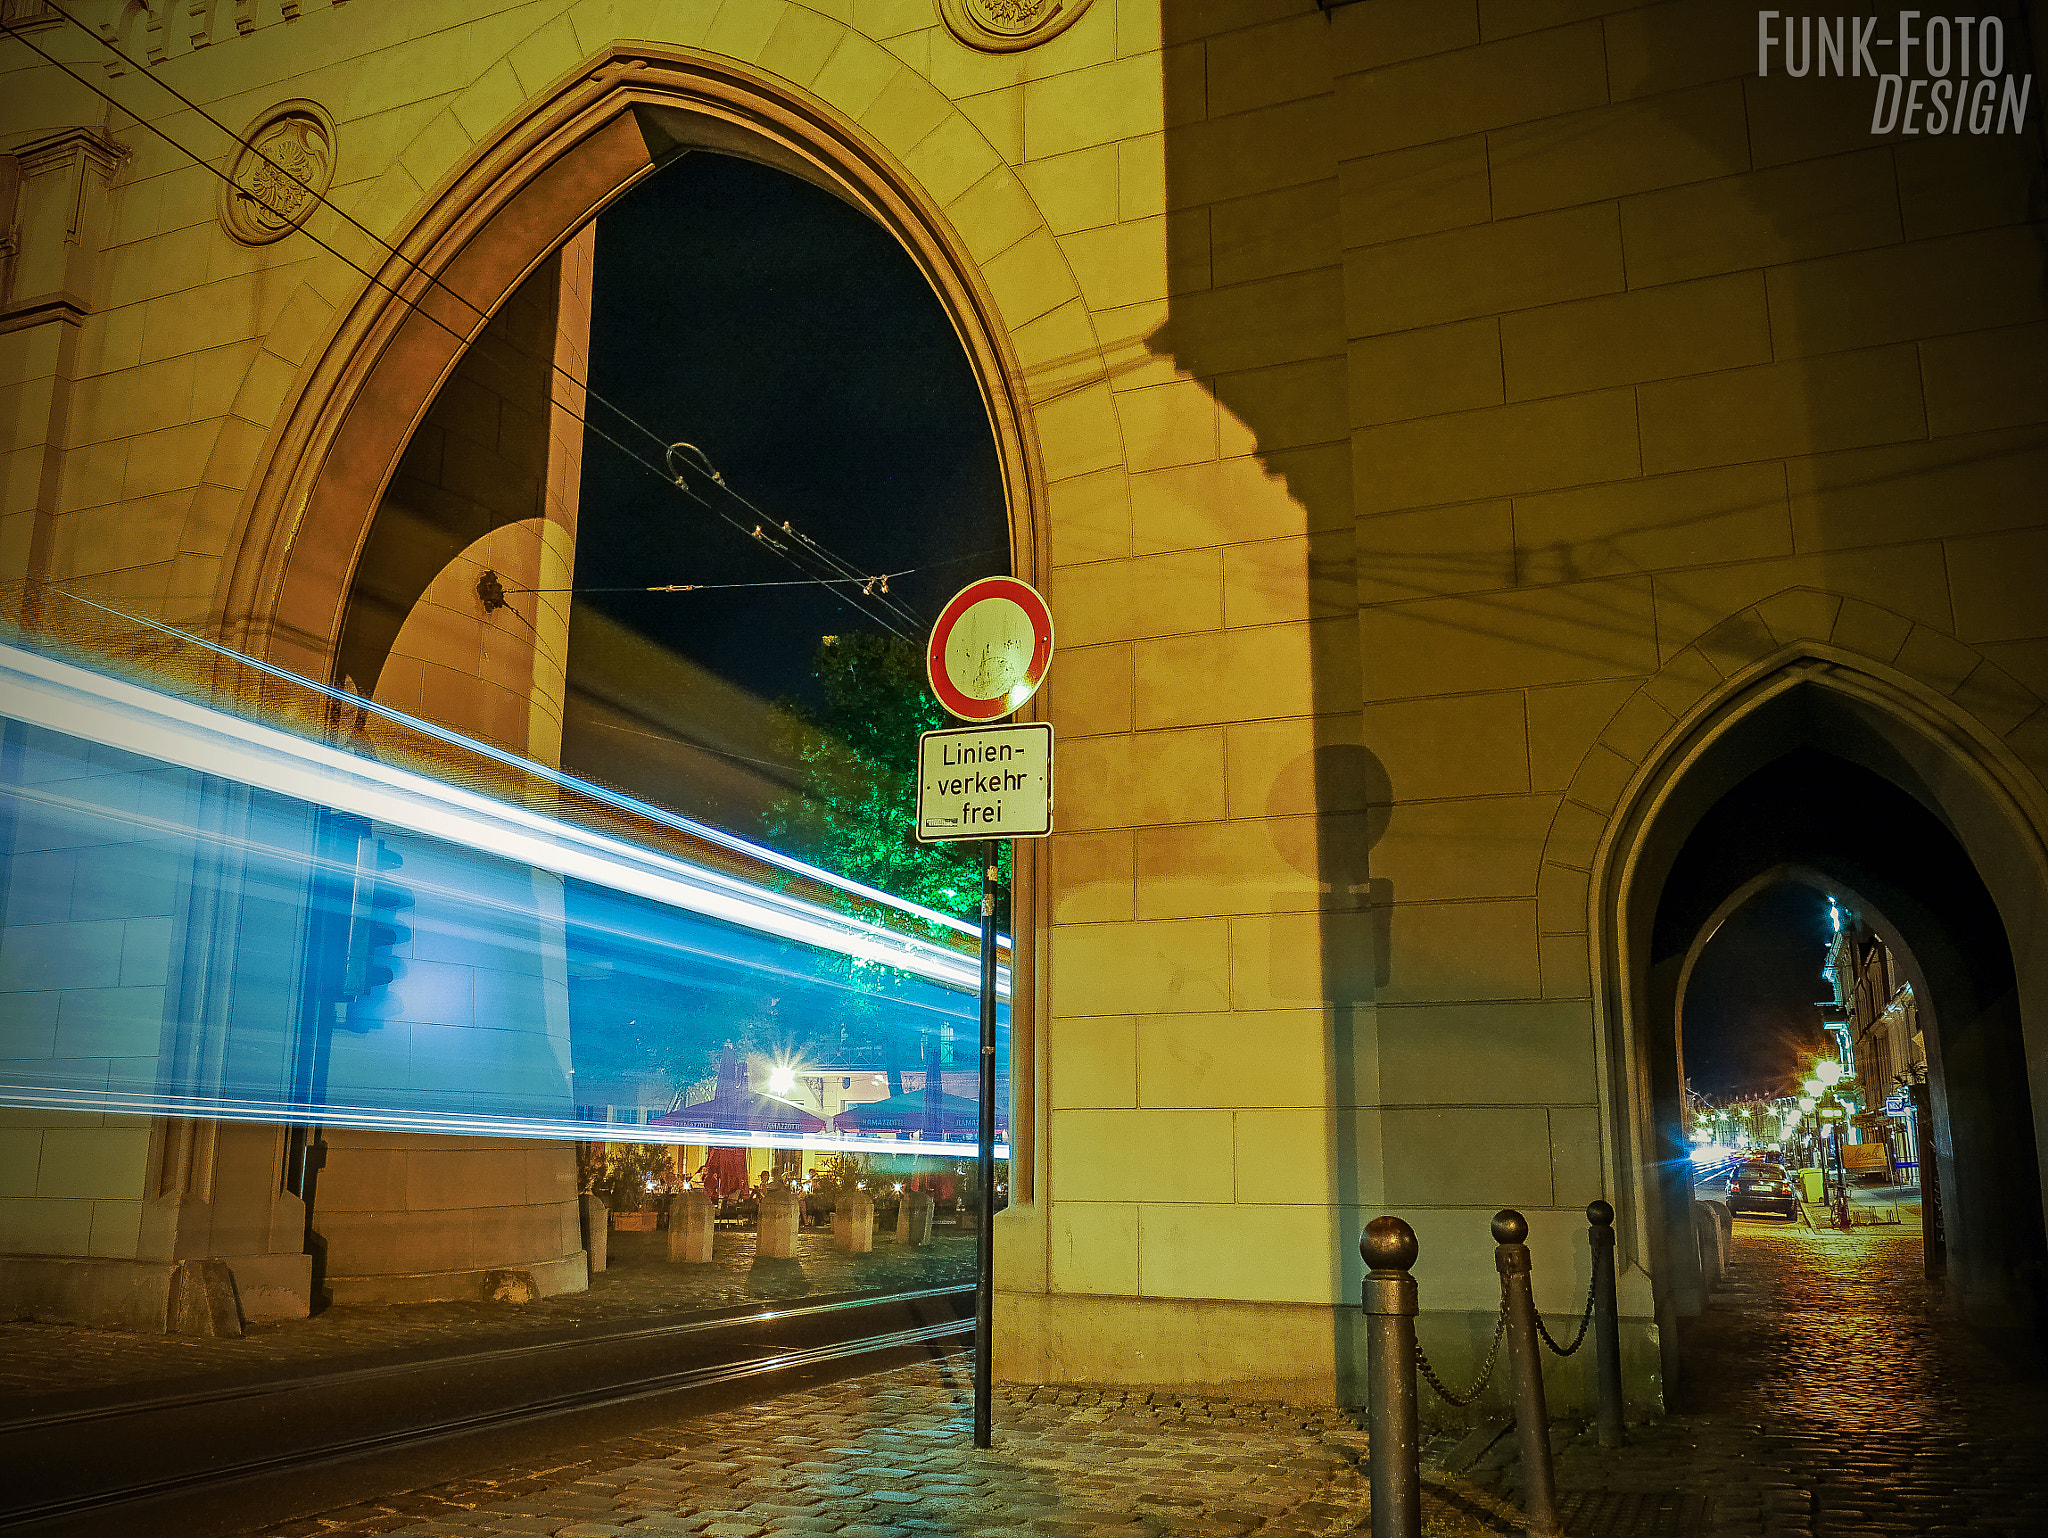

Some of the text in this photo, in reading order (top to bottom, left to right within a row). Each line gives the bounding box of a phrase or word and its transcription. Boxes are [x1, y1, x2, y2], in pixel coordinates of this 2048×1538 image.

[943, 740, 1025, 765] Linien-
[937, 769, 1028, 796] verkehr
[962, 799, 1002, 824] frei
